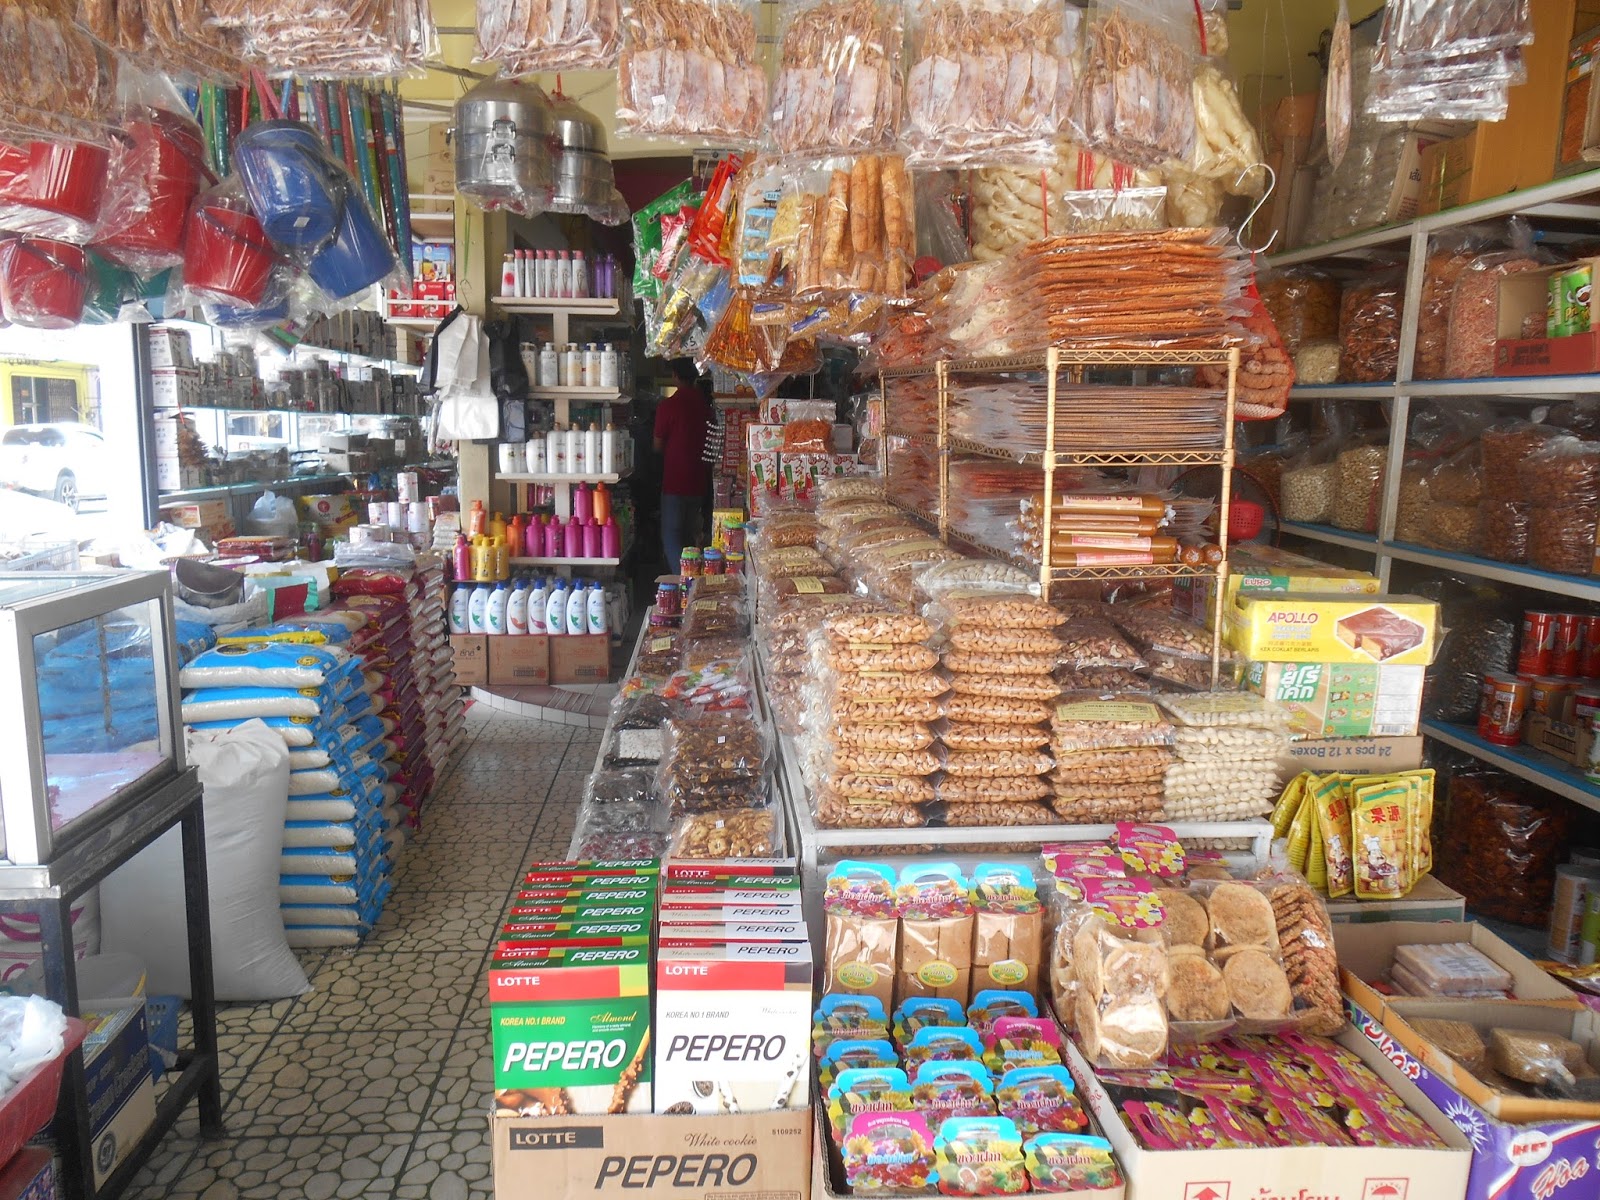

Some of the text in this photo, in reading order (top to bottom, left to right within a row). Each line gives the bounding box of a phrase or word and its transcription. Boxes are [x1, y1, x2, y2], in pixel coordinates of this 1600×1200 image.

[1244, 578, 1271, 586] EURO
[1267, 612, 1319, 624] APOLLO
[1329, 746, 1341, 756] 12
[1345, 747, 1352, 755] x
[1355, 745, 1375, 756] pcs
[1379, 745, 1392, 755] 24
[591, 876, 650, 885] PEPERO
[586, 890, 647, 900] PEPERO
[581, 907, 645, 917] PEPERO
[576, 924, 642, 934] PEPERO
[736, 925, 795, 933] PEPERO
[737, 946, 799, 955] PEPERO
[570, 950, 640, 962] PEPERO
[665, 966, 708, 976] LOTTE
[497, 976, 540, 987] LOTTE
[590, 1011, 637, 1024] Almond
[666, 1011, 688, 1019] KOREA
[500, 1017, 524, 1026] KOREA
[541, 1016, 566, 1025] BRAND
[665, 1034, 786, 1061] PEPERO
[502, 1038, 627, 1072] PEPERO
[516, 1131, 577, 1145] LOTTE
[684, 1132, 757, 1147] White cookie
[594, 1153, 758, 1190] PEPERO
